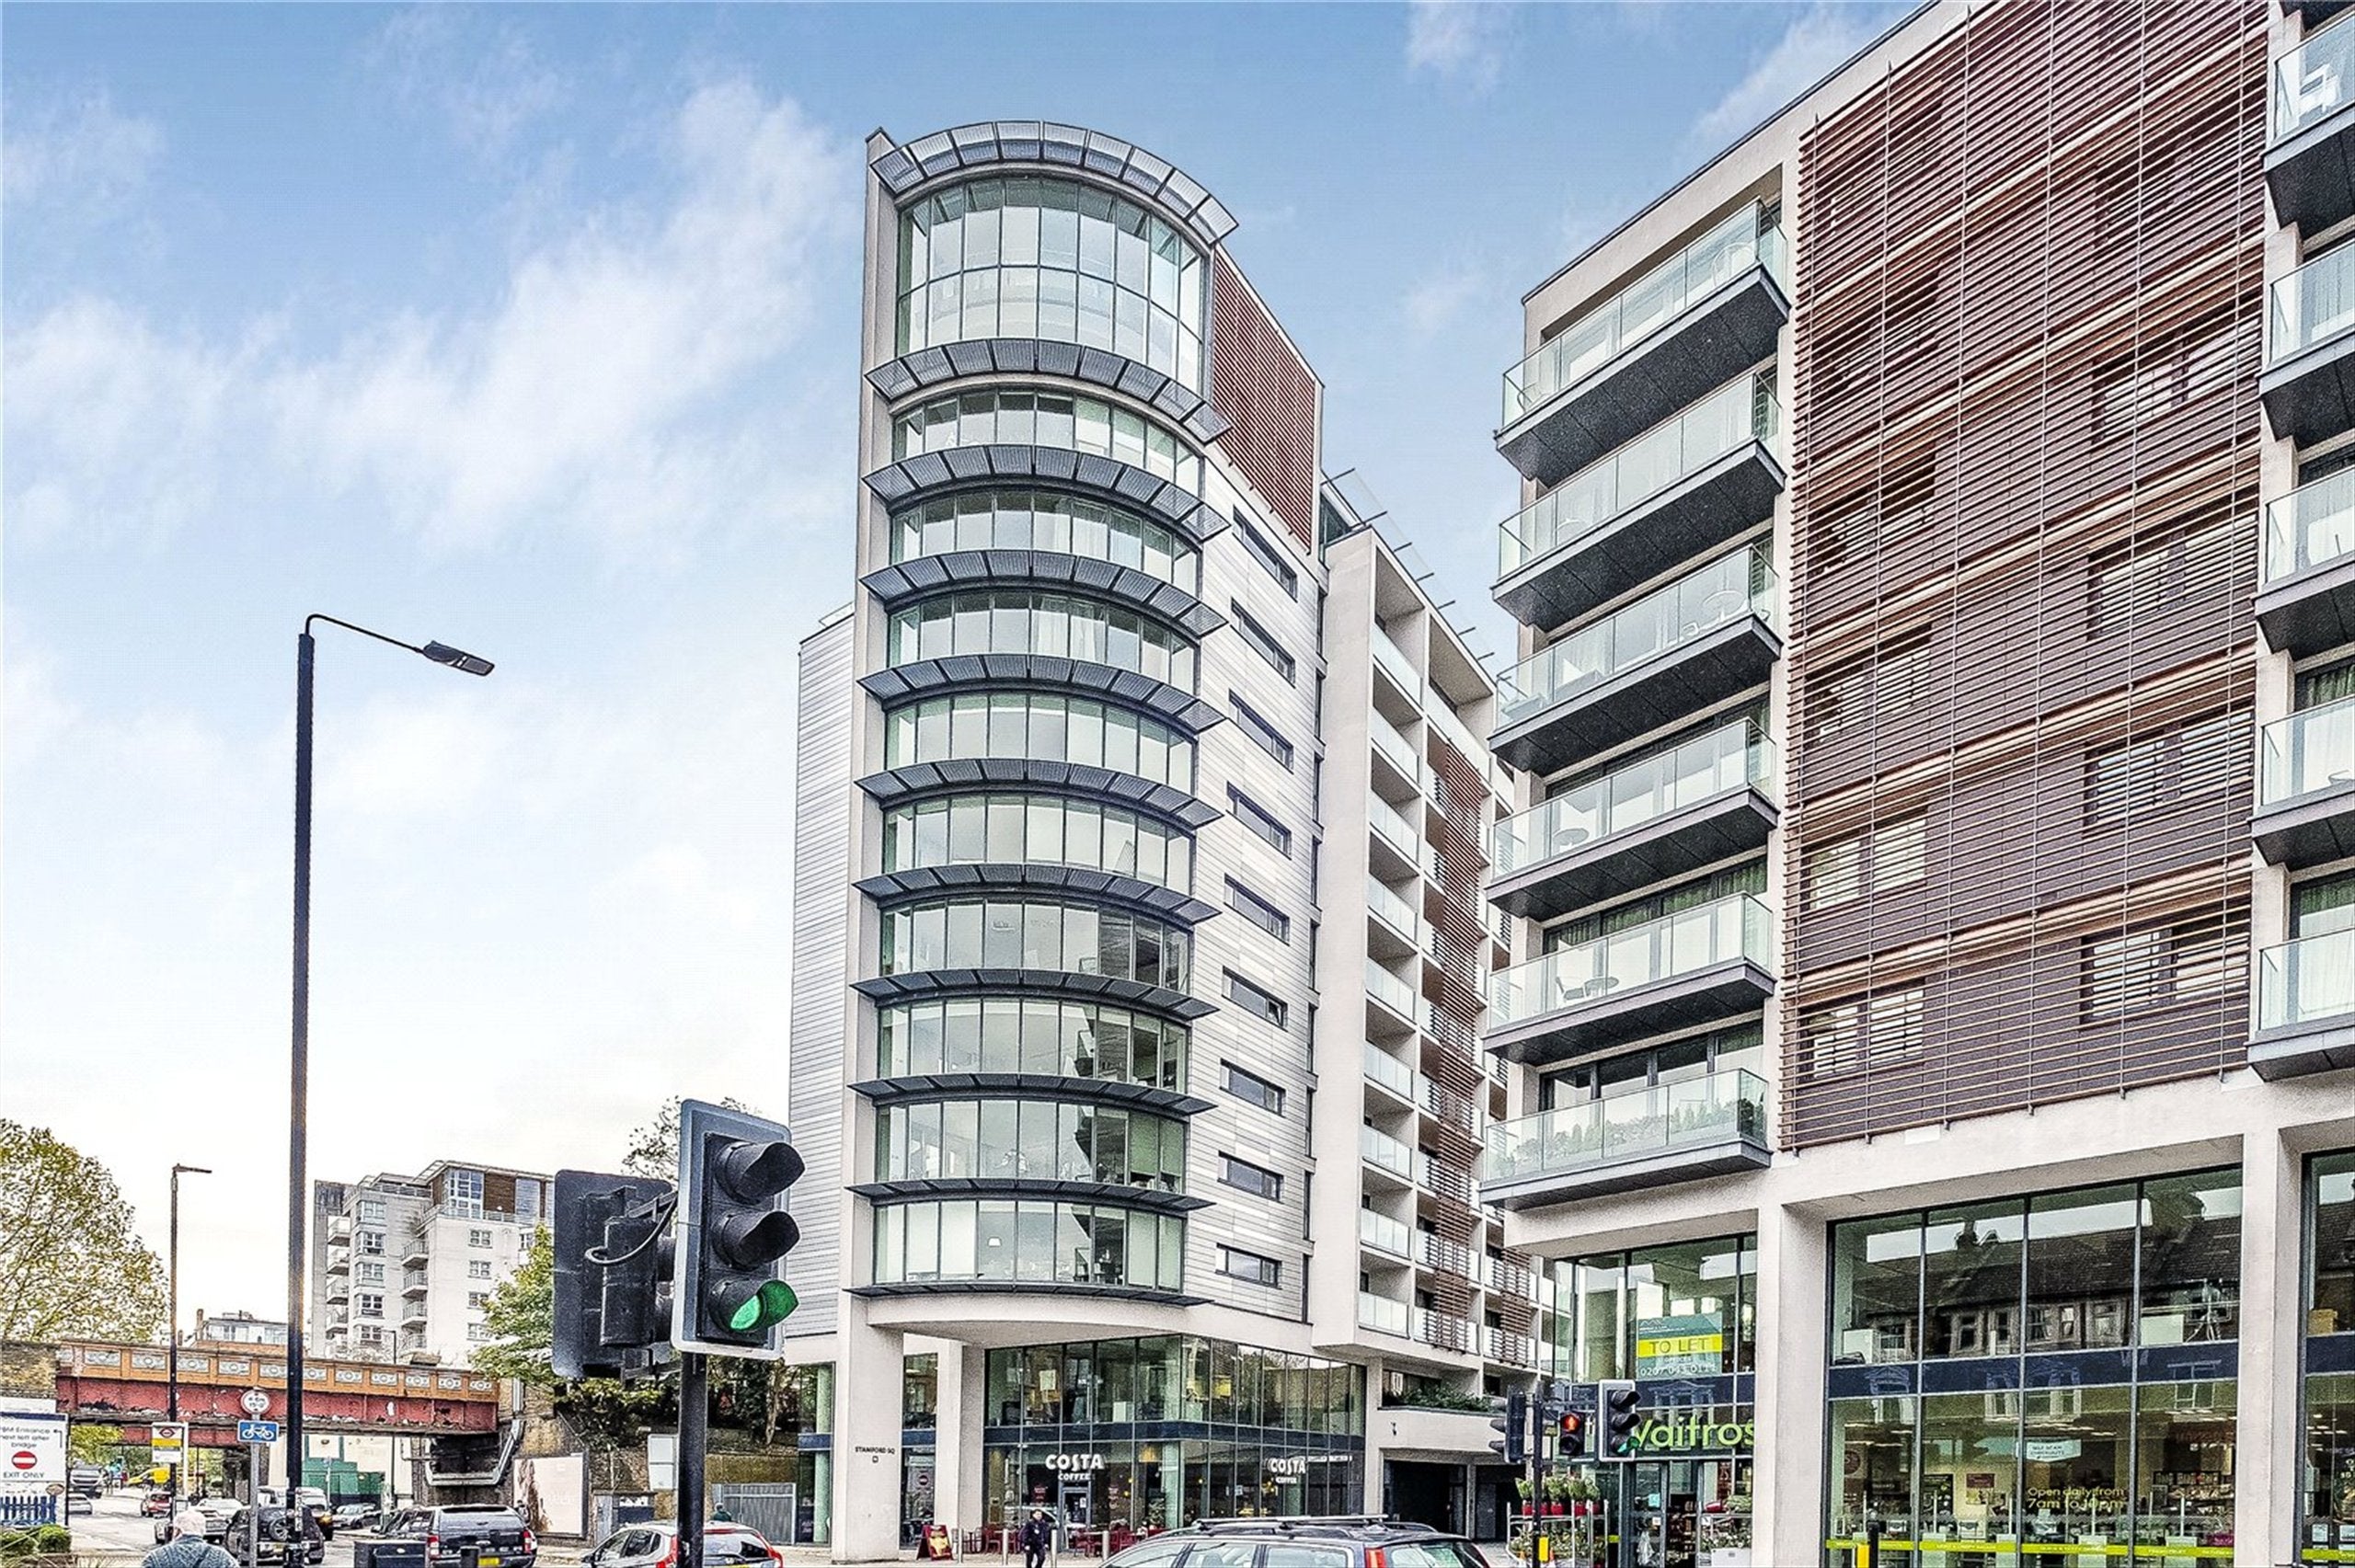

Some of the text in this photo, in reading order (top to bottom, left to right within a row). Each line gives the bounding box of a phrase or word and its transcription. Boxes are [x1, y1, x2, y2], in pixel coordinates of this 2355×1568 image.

[1649, 1337, 1709, 1354] TO LET
[1634, 1414, 1753, 1448] Waitros
[1045, 1453, 1105, 1471] COSTA
[1269, 1457, 1306, 1475] COSTA
[1057, 1472, 1091, 1481] COFFEE
[2028, 1485, 2125, 1498] Open daily from
[2028, 1498, 2061, 1509] 7am
